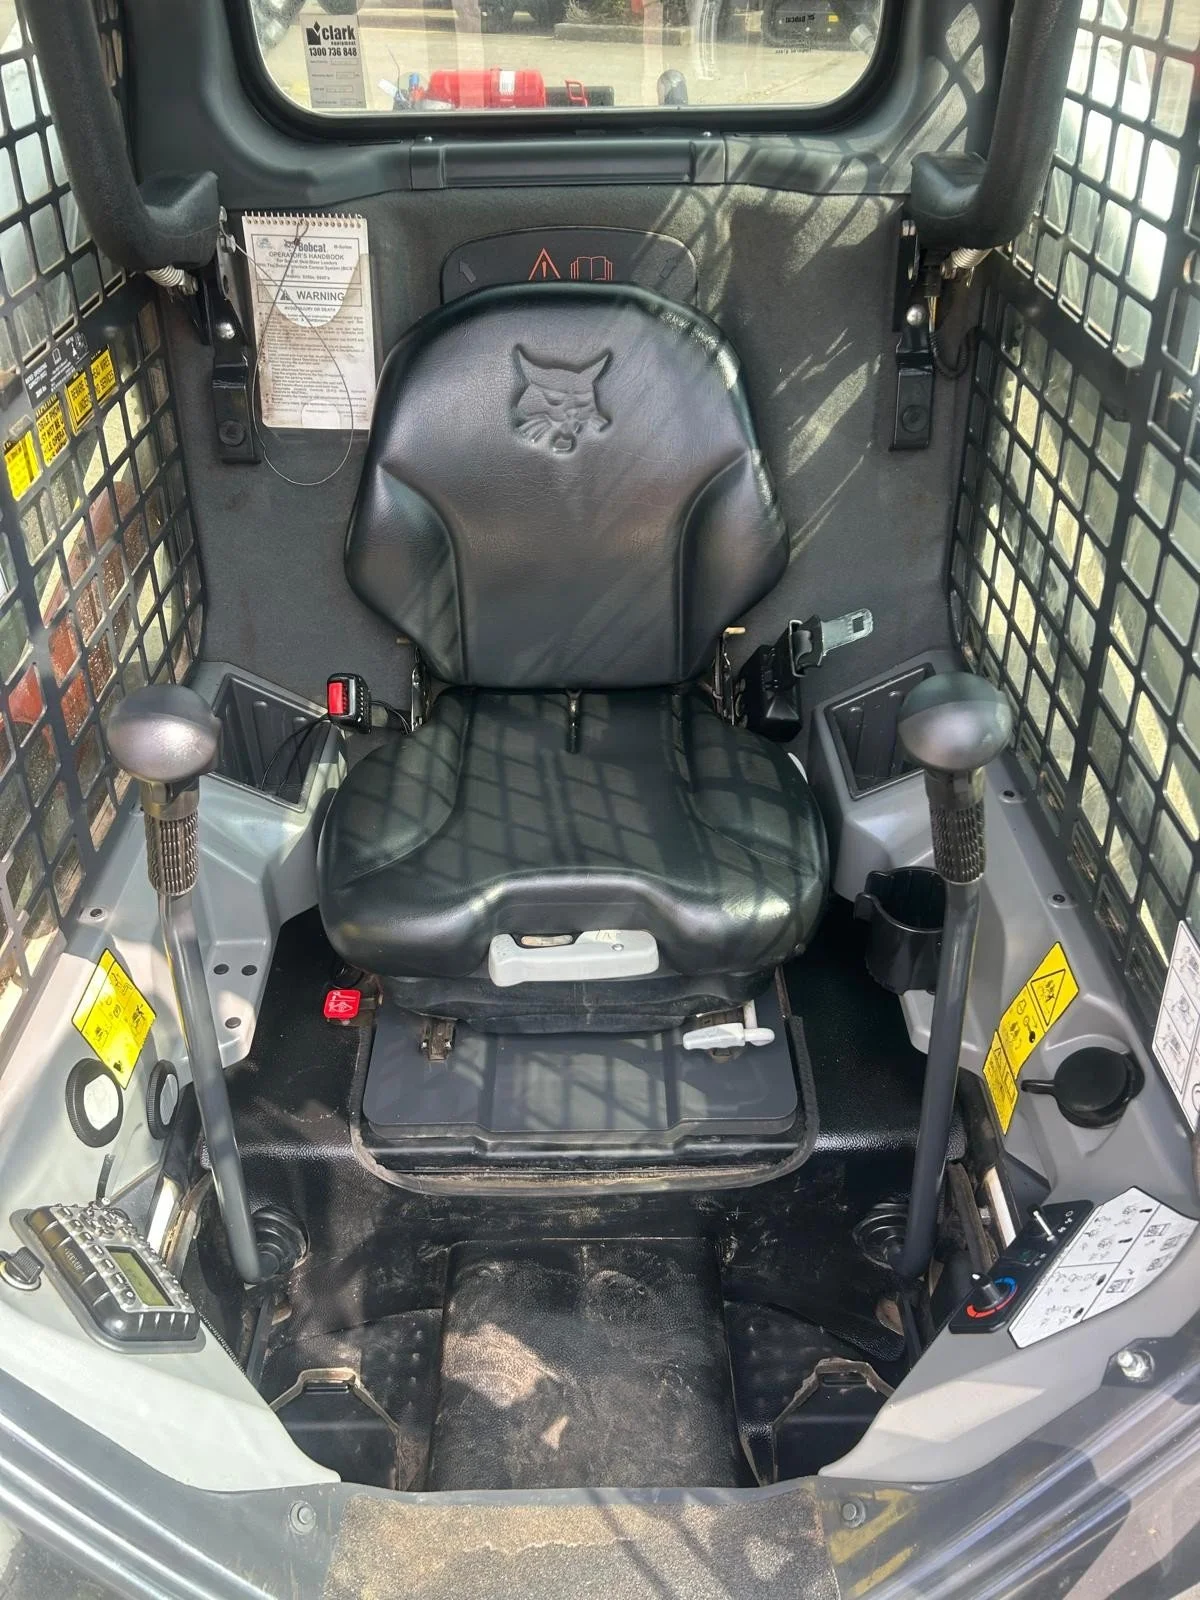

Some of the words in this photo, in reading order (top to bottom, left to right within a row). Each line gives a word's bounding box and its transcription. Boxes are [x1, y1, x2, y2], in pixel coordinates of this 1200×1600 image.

[321, 25, 356, 40] clark
[309, 47, 327, 57] 1300
[328, 47, 342, 57] 736
[343, 47, 358, 57] 848
[298, 242, 327, 253] Bobcat
[268, 251, 308, 259] OPERATOR'S
[296, 290, 344, 301] WARNING
